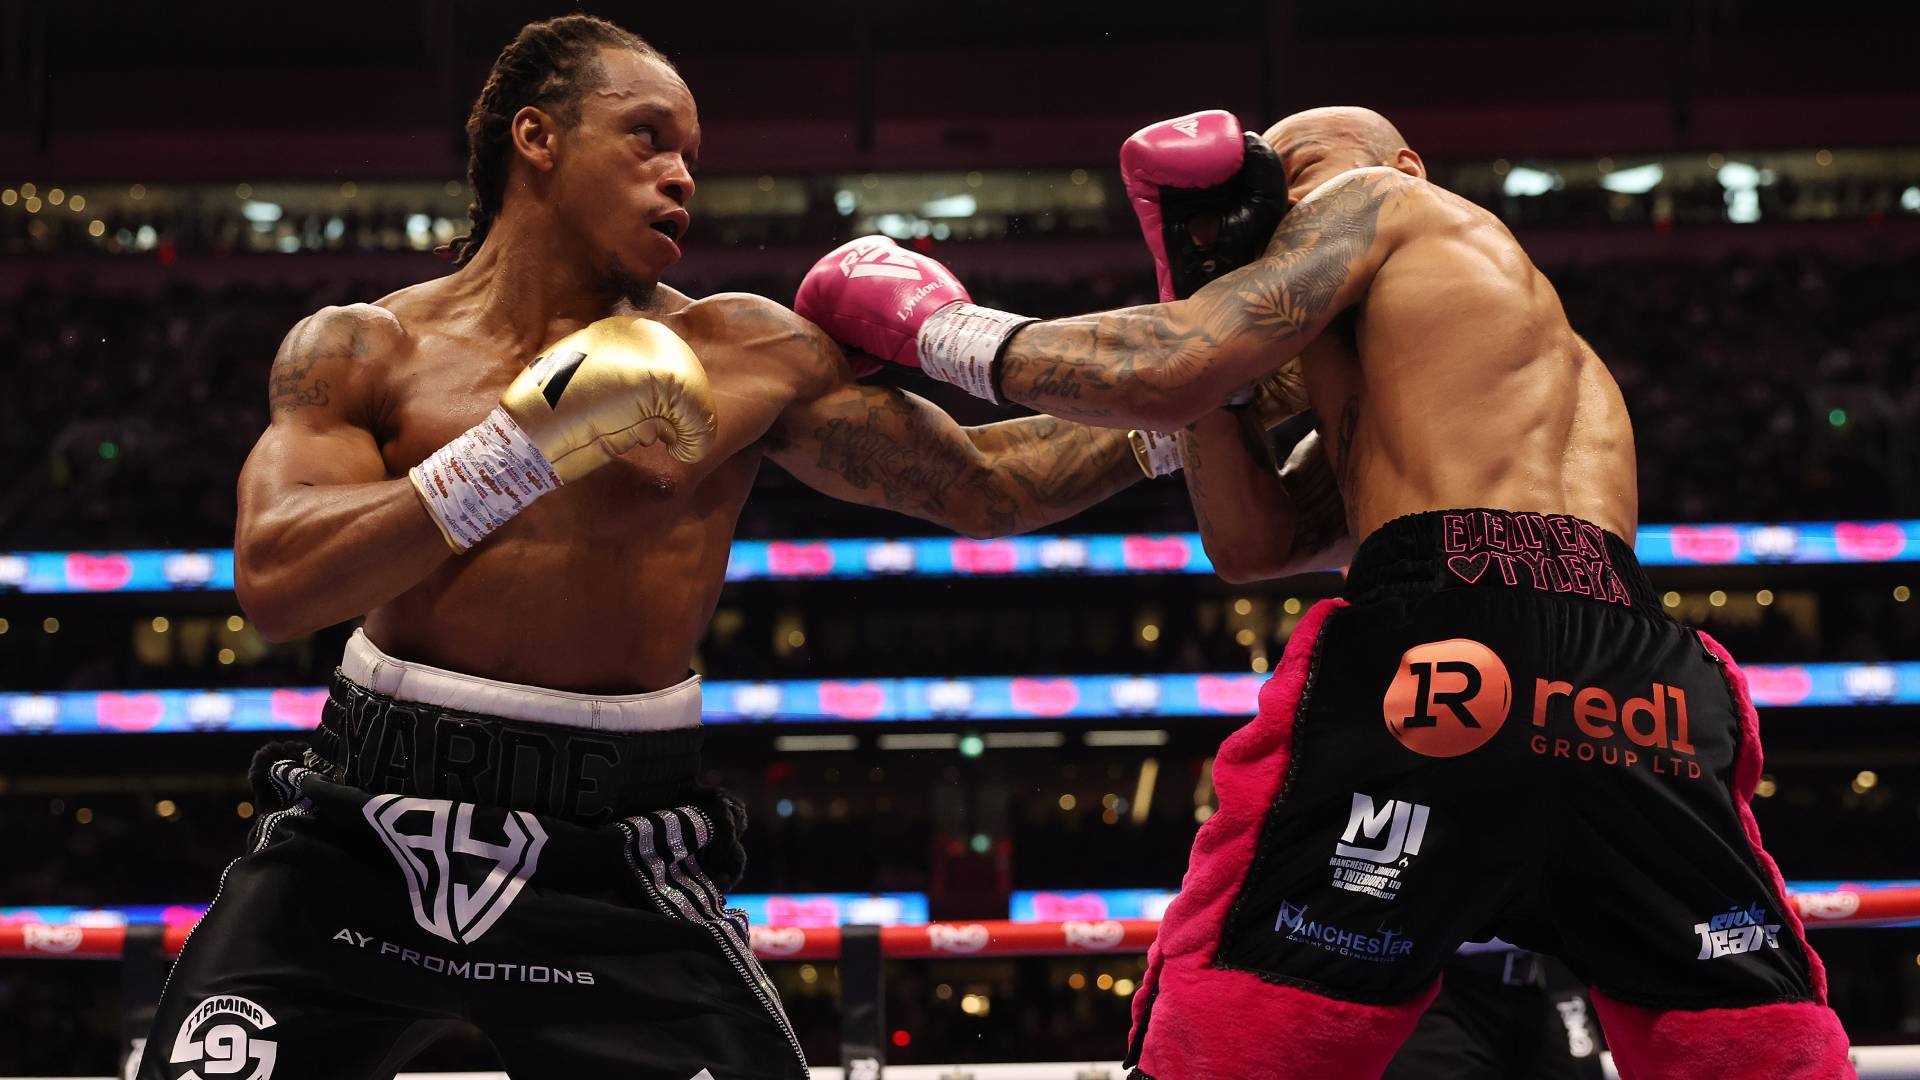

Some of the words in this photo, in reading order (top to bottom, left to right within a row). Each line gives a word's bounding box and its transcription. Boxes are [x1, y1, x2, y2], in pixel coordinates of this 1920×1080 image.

[897, 279, 939, 321] Lyndon
[1531, 735, 1639, 767] GROUP
[1653, 755, 1701, 780] LTD
[1329, 857, 1375, 873] MANCHESTER
[1333, 867, 1342, 879] &
[1388, 880, 1401, 890] LTD
[1275, 899, 1414, 955] MANCHESTER
[332, 928, 375, 948] AY
[380, 942, 595, 985] PROMOTIONS
[186, 998, 264, 1036] STAMINA
